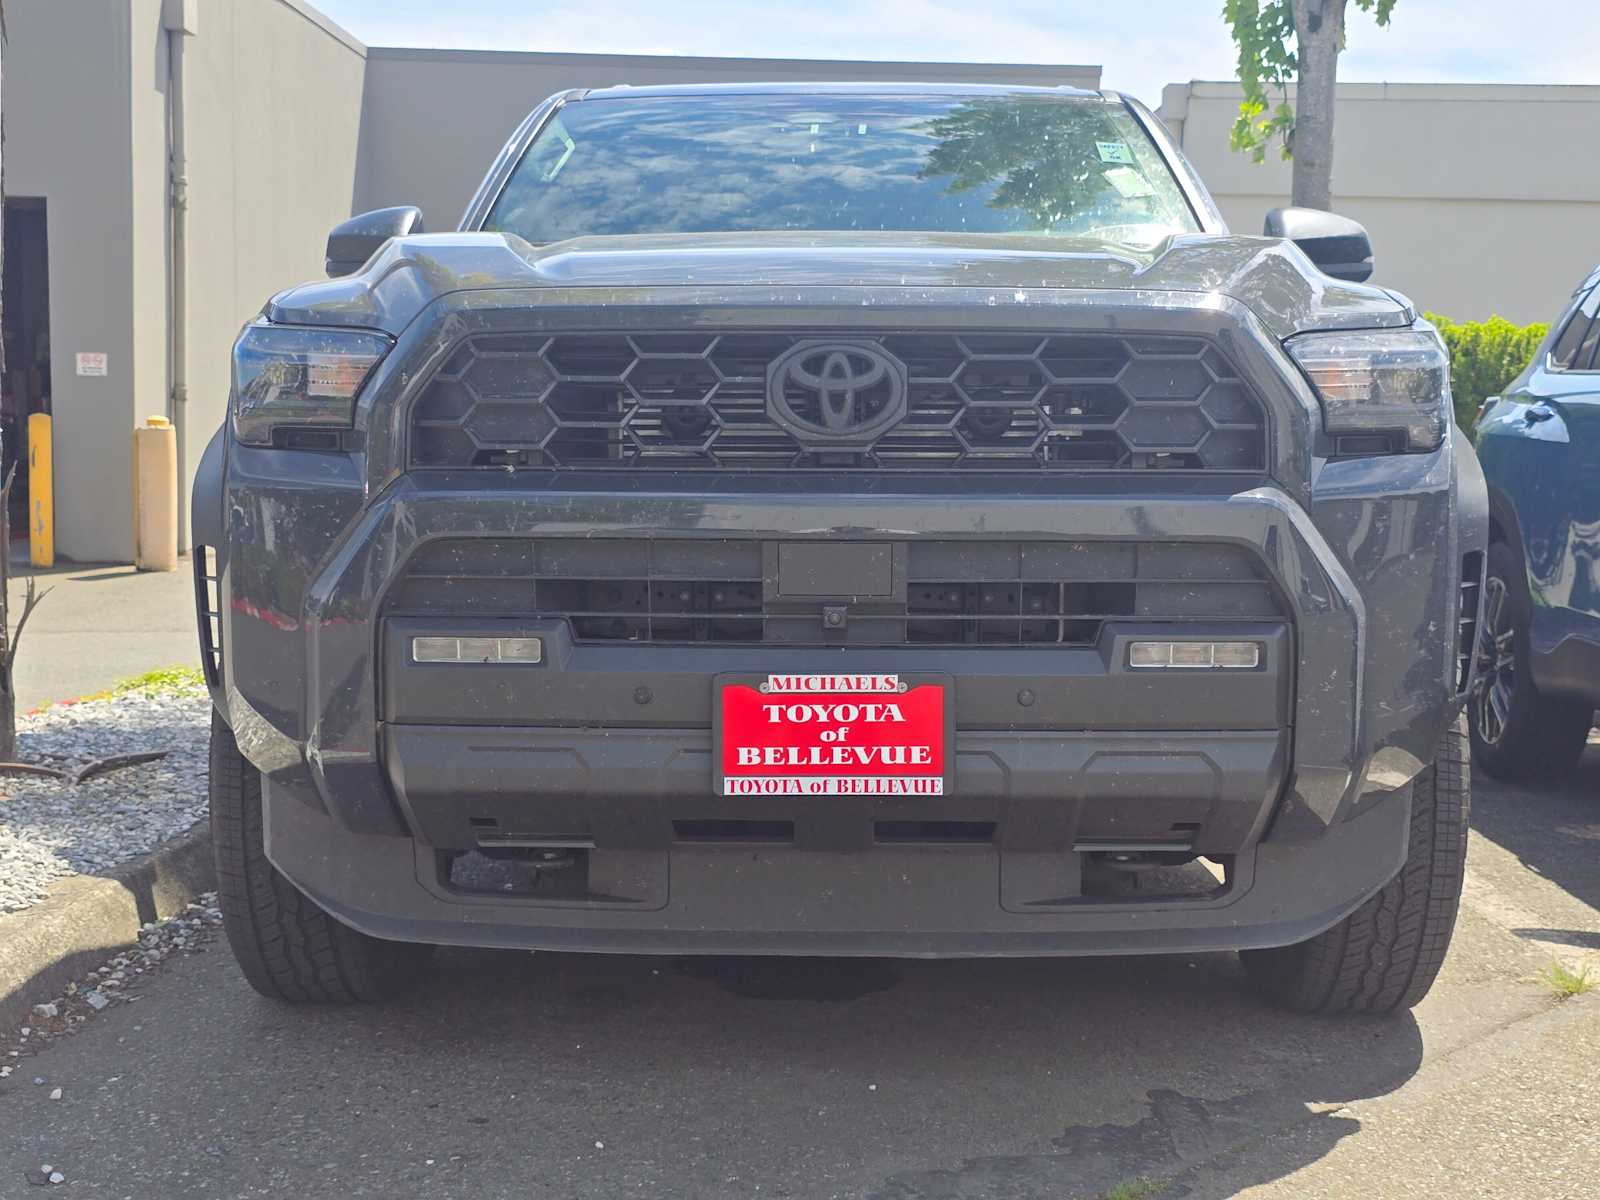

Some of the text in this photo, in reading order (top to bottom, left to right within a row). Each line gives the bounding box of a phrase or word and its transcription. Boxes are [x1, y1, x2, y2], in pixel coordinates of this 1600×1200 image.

[772, 676, 897, 691] MICHAELS
[763, 703, 905, 723] TOYOTA
[819, 727, 849, 742] of
[736, 745, 932, 765] BELLEVUE
[726, 778, 942, 794] TOYOTA of BELLEVUE
